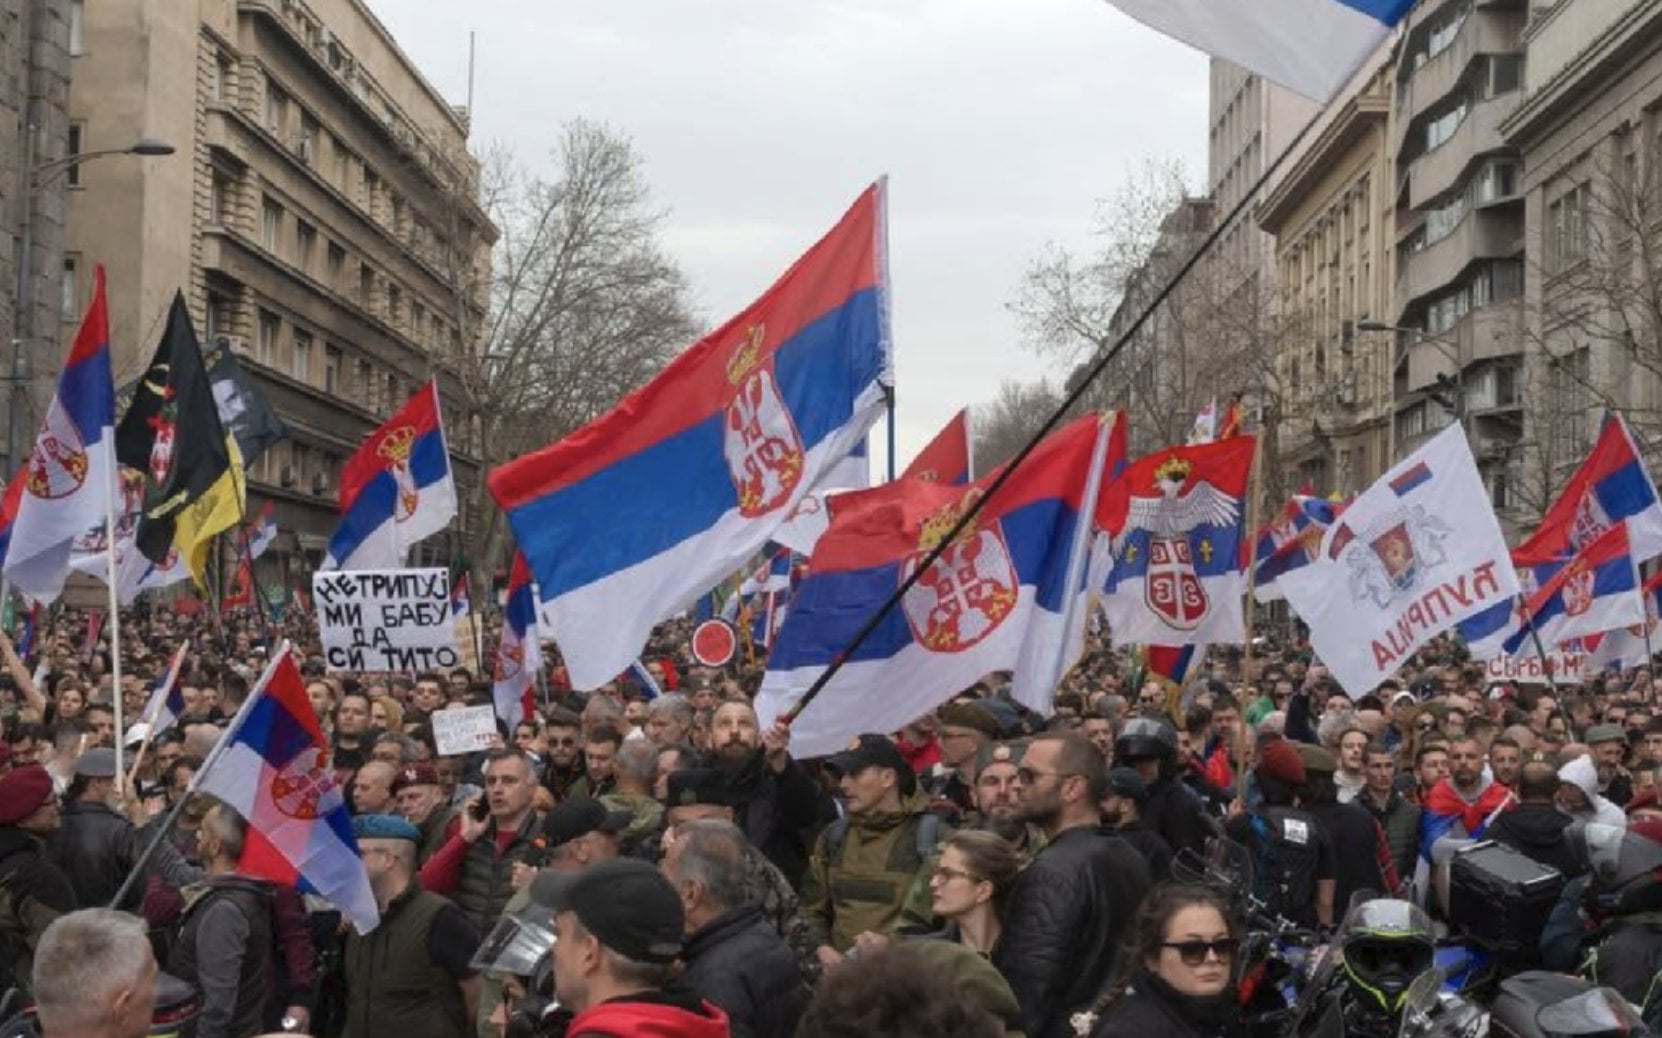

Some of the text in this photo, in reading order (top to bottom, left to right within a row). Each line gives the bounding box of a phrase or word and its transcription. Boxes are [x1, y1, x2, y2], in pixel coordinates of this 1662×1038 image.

[325, 602, 448, 627] МИ БАБУ
[350, 627, 393, 649] ДА
[328, 646, 457, 671] СИ ТИТО
